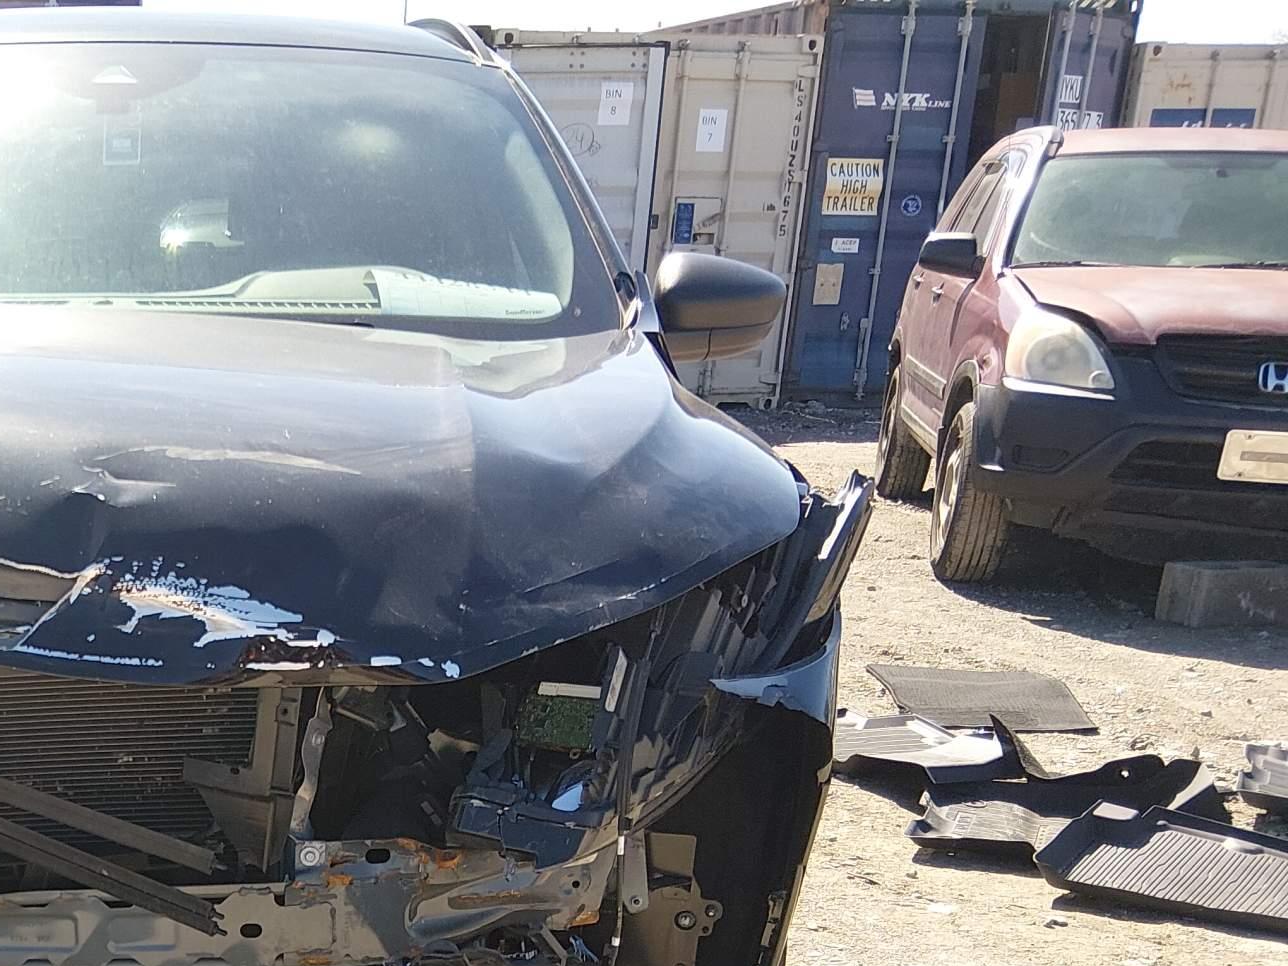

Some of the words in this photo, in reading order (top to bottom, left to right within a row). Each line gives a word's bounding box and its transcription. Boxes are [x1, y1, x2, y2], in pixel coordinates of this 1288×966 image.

[605, 89, 622, 99] BIN
[1059, 77, 1082, 102] YKU
[881, 92, 930, 107] NYK
[927, 99, 952, 109] LINE
[610, 105, 617, 116] 8
[701, 116, 718, 126] BIN
[707, 132, 713, 142] 7
[830, 162, 880, 178] CAUTION
[840, 180, 867, 195] HIGH
[826, 195, 875, 212] TRAILER
